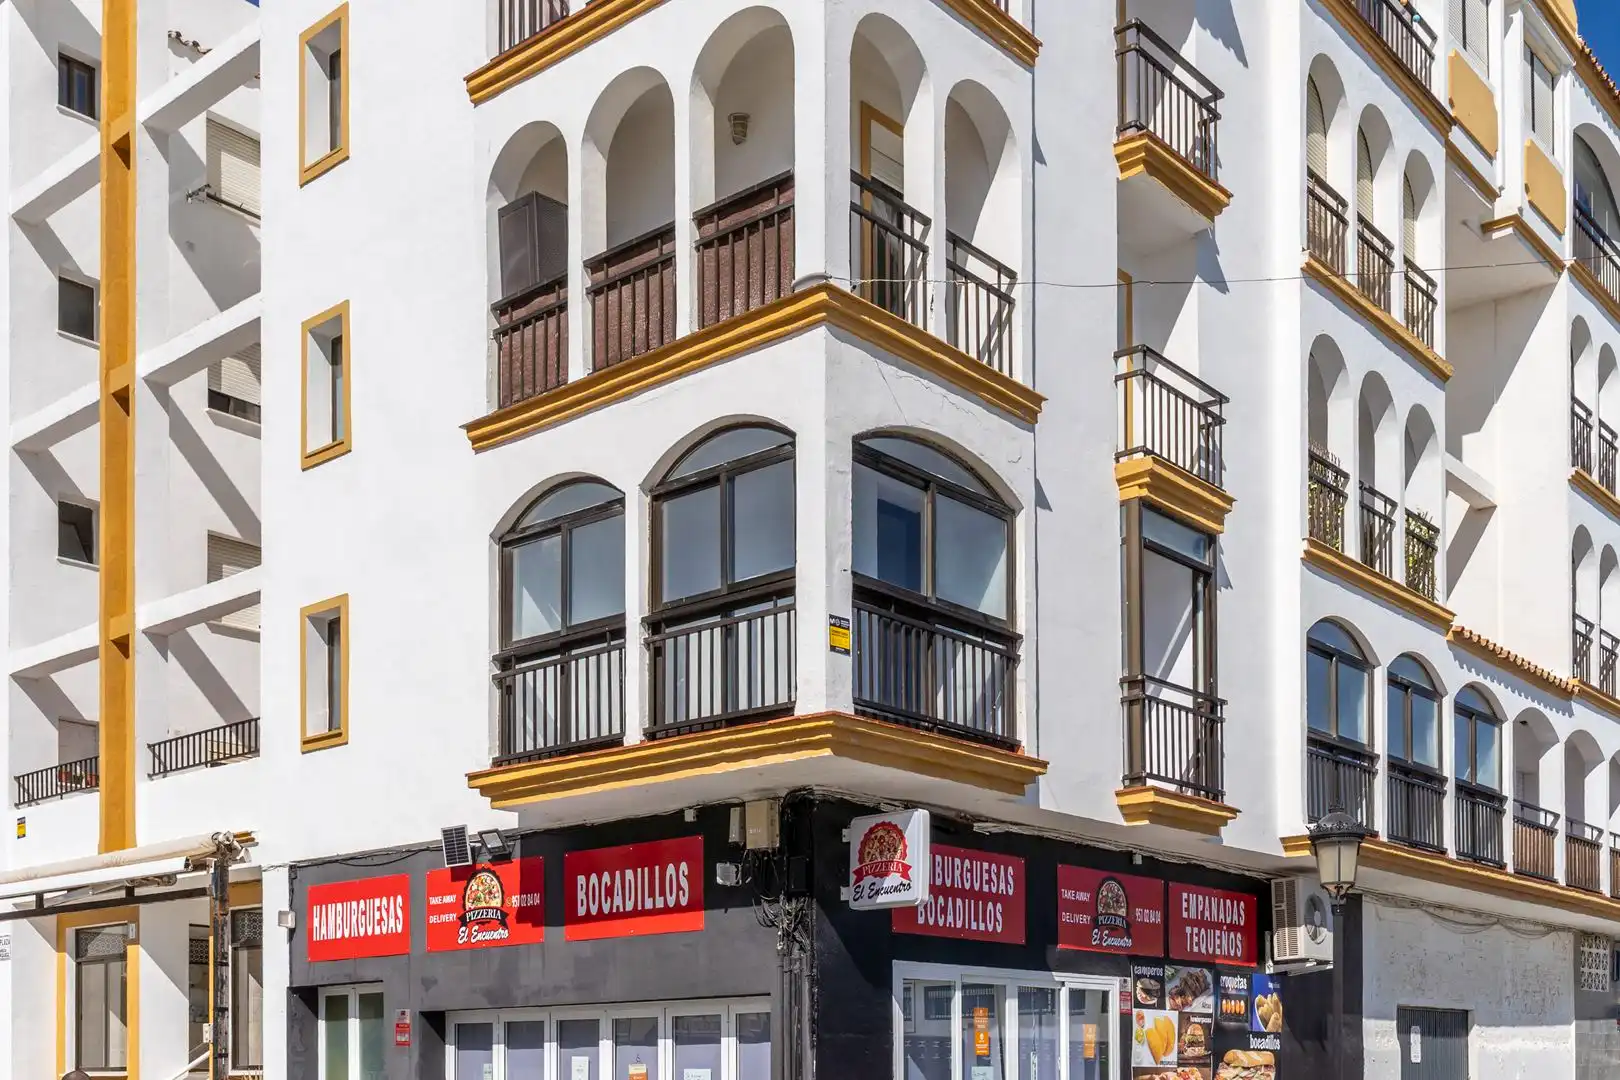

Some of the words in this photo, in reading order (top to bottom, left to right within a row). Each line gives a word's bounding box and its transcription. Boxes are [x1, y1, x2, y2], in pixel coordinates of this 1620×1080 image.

[862, 861, 903, 875] PIZZERIA
[929, 853, 1014, 896] BURGUESAS
[577, 861, 689, 917] BOCADILLOS
[852, 884, 865, 902] El
[867, 880, 912, 900] Encuentro
[1061, 888, 1075, 900] TAKE
[1075, 890, 1091, 902] AWAY
[313, 894, 403, 941] HAMBURGUESAS
[466, 908, 501, 922] PIZZERIA
[917, 894, 1003, 933] BOCADILLOS
[1182, 892, 1245, 926] EMPANADAS
[429, 913, 457, 924] DELIVERY
[1061, 912, 1091, 925] DELIVERY
[1098, 915, 1127, 929] PIZZERIA
[457, 926, 469, 945] El
[470, 925, 509, 943] Encuentro
[1091, 928, 1101, 946] El
[1102, 930, 1132, 948] Encuentro
[1185, 925, 1242, 958] TEQUEÑOS
[1134, 965, 1163, 978] camperos
[1220, 974, 1247, 991] croquetas
[1249, 1034, 1281, 1051] bocadillos
